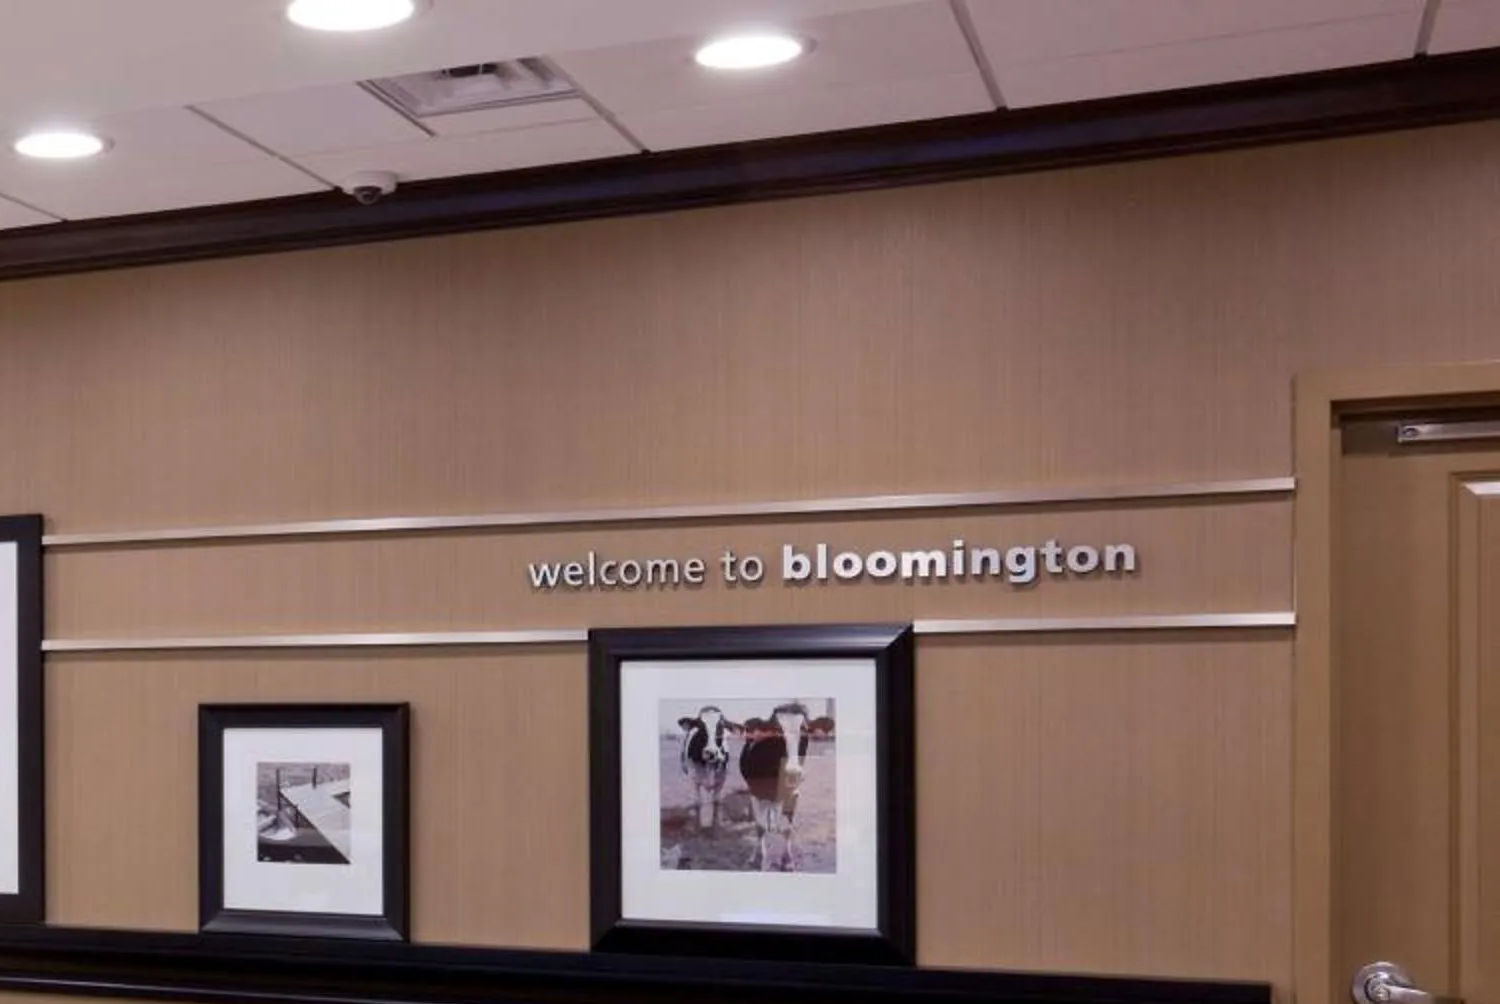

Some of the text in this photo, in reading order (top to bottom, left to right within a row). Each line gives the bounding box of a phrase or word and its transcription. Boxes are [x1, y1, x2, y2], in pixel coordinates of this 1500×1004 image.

[529, 539, 1136, 587] welcome to bloomington
